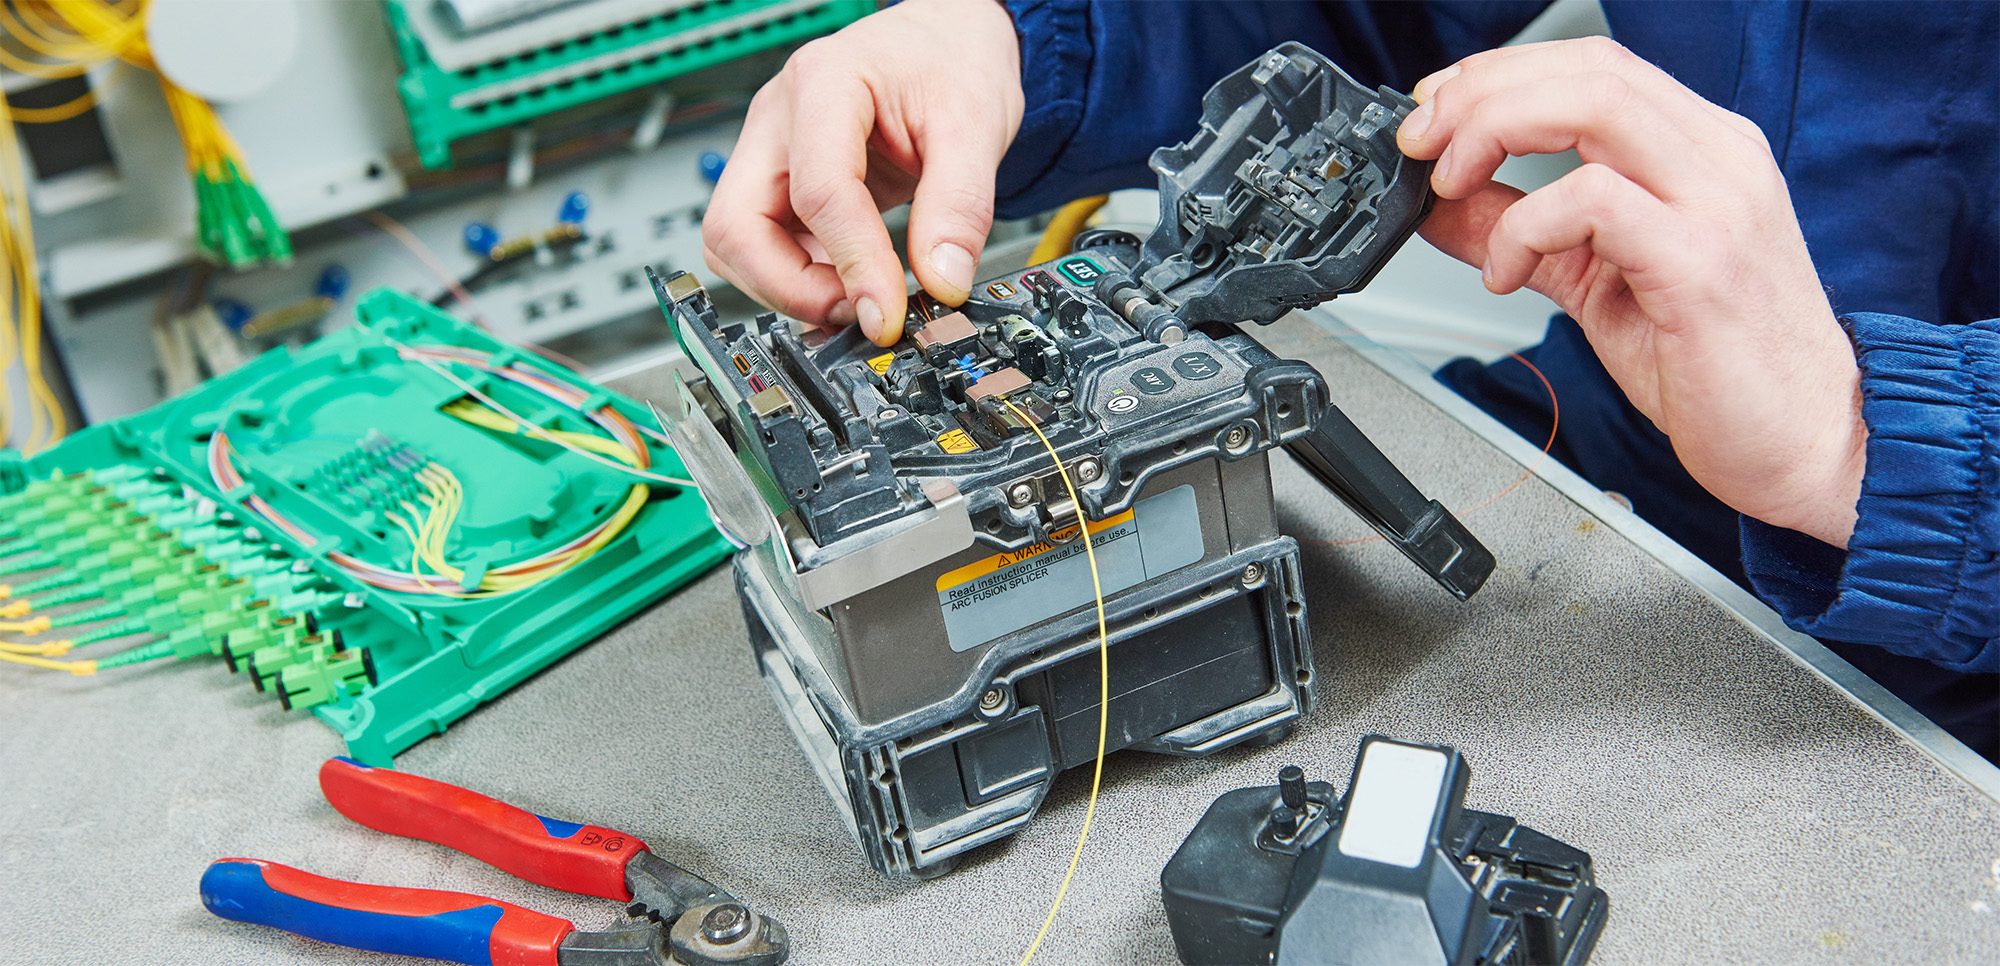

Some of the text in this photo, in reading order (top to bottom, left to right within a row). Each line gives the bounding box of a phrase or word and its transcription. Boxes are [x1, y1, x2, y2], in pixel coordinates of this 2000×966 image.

[1066, 262, 1099, 279] SET
[1182, 357, 1211, 374] X/Y
[1141, 372, 1165, 386] ARC
[949, 527, 1130, 600] Read instruction manual beore use.
[951, 568, 1049, 612] ARC FUSION SPLICER
